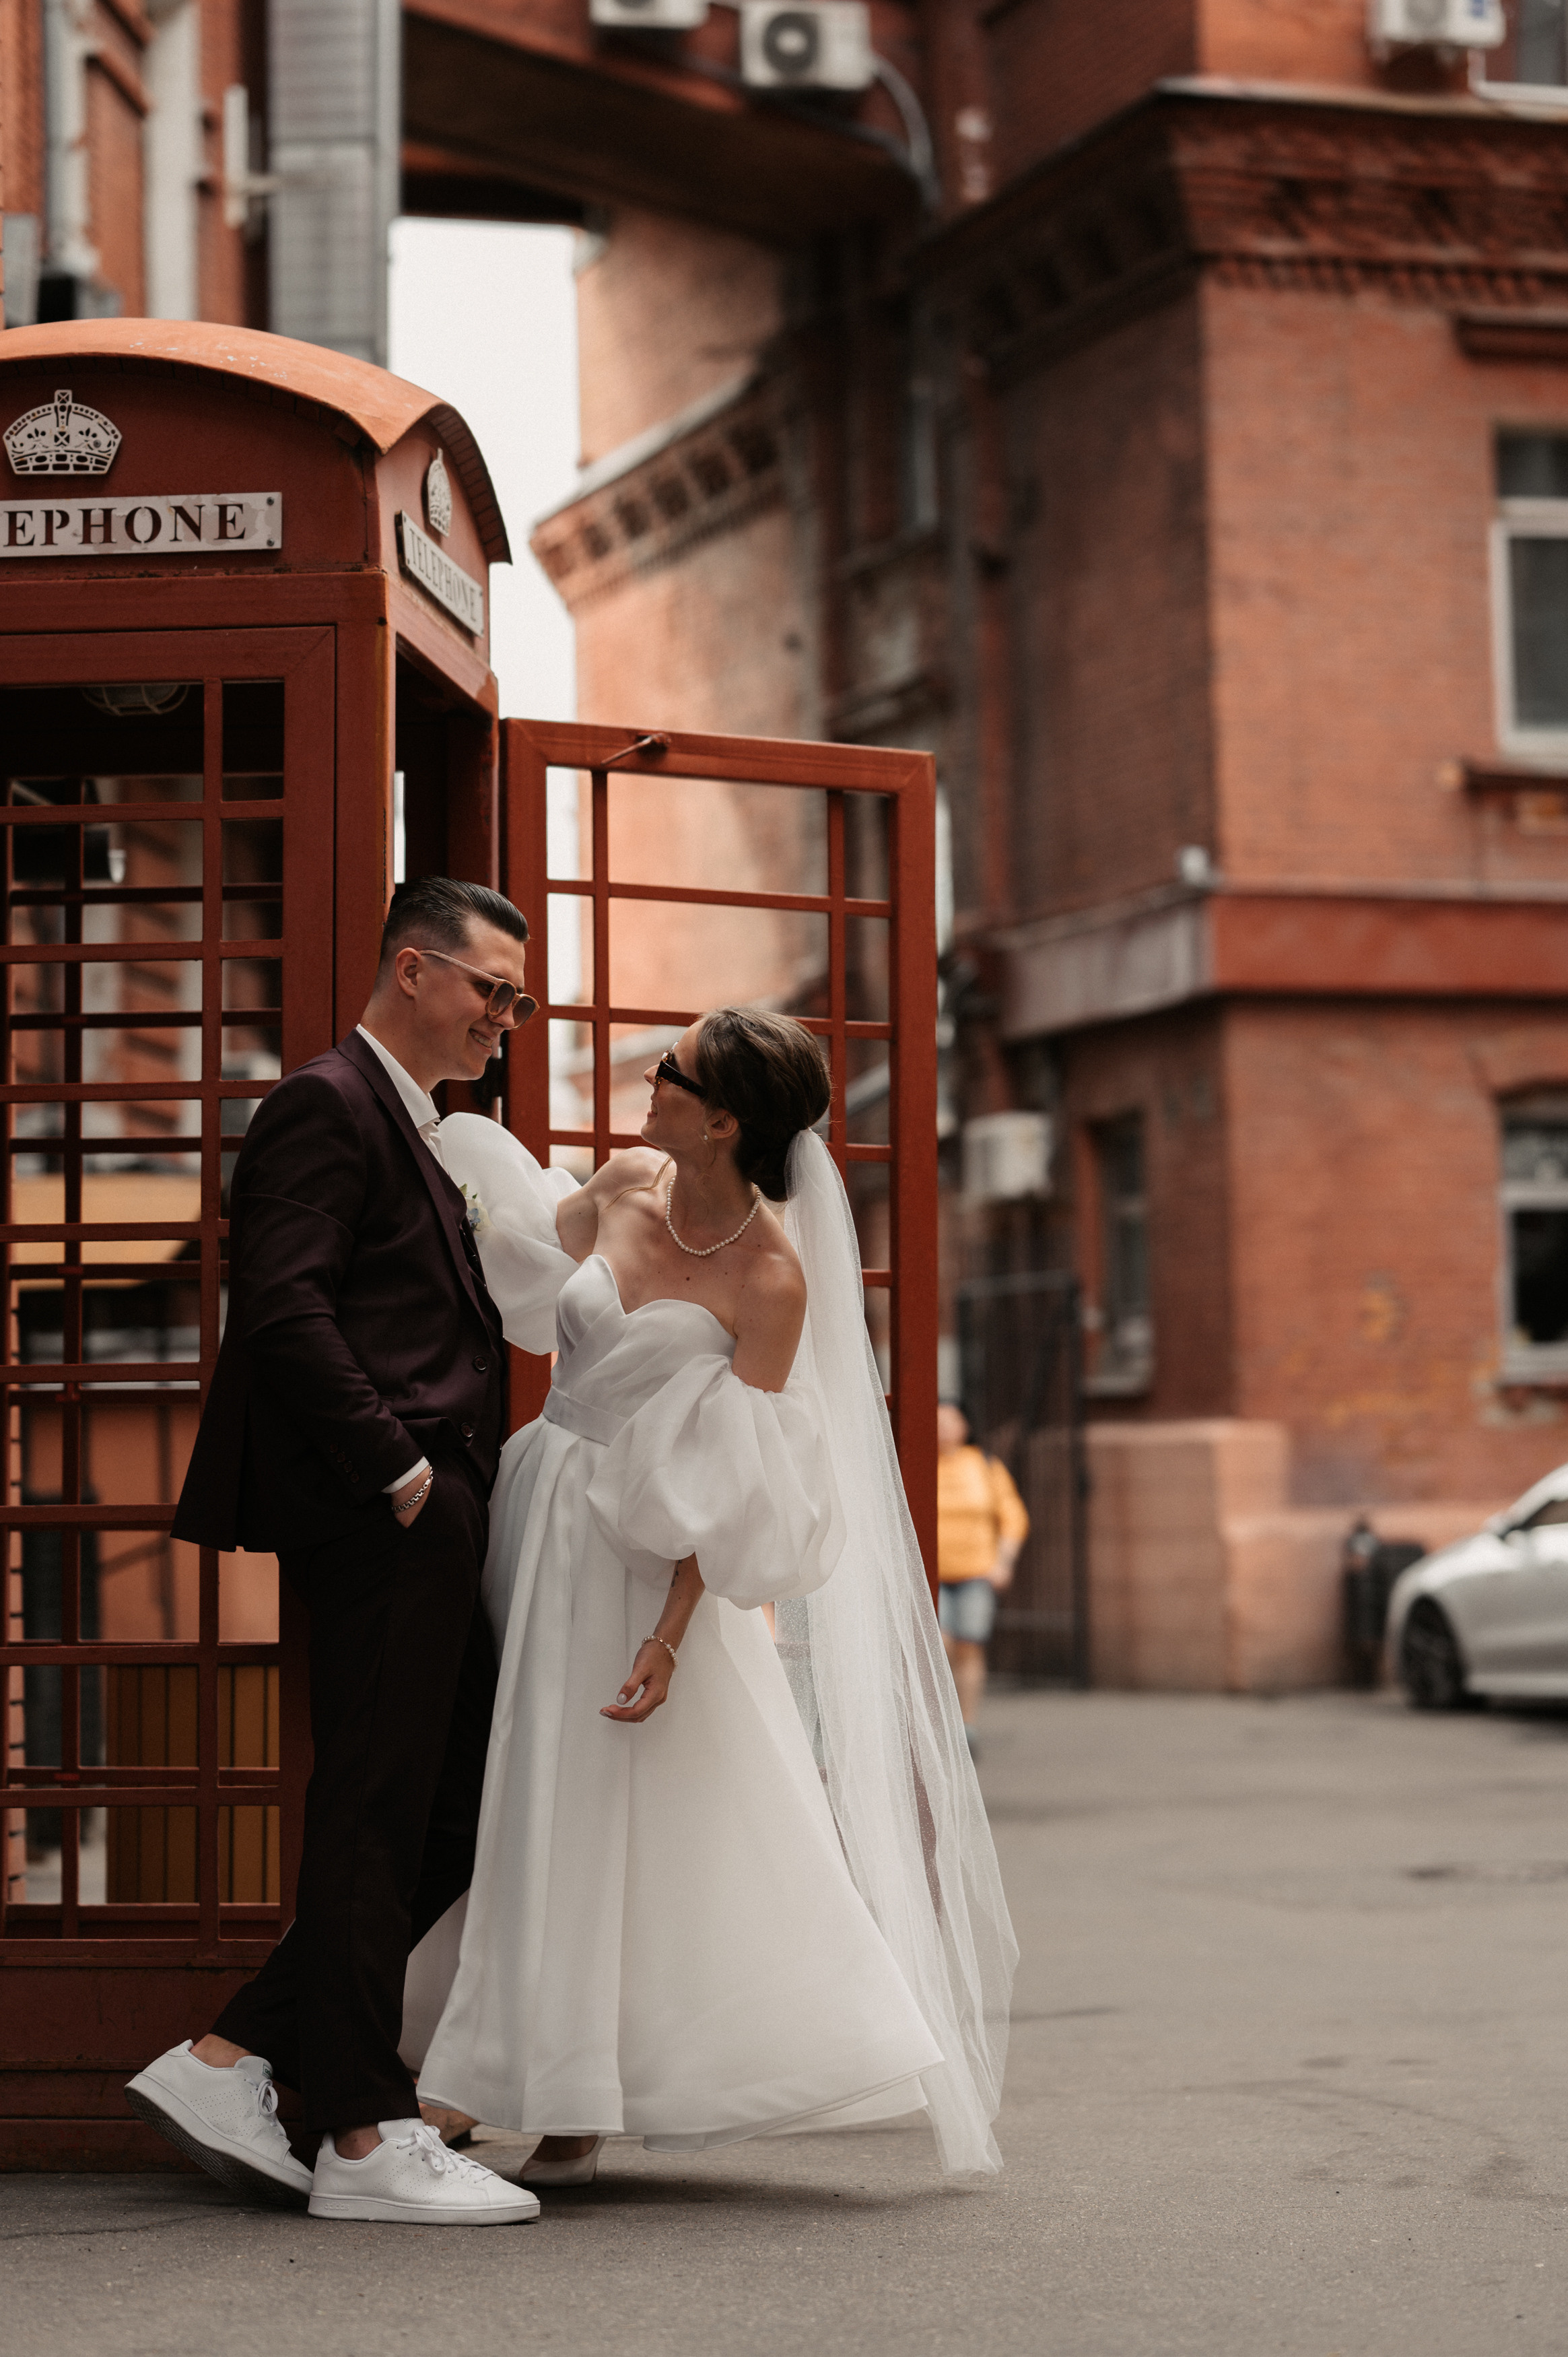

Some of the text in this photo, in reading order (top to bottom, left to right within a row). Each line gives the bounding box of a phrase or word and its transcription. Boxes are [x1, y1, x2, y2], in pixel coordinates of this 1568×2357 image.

[3, 503, 246, 547] EPHONE
[409, 529, 476, 622] TELEPHONE
[324, 2201, 350, 2211] adidas
